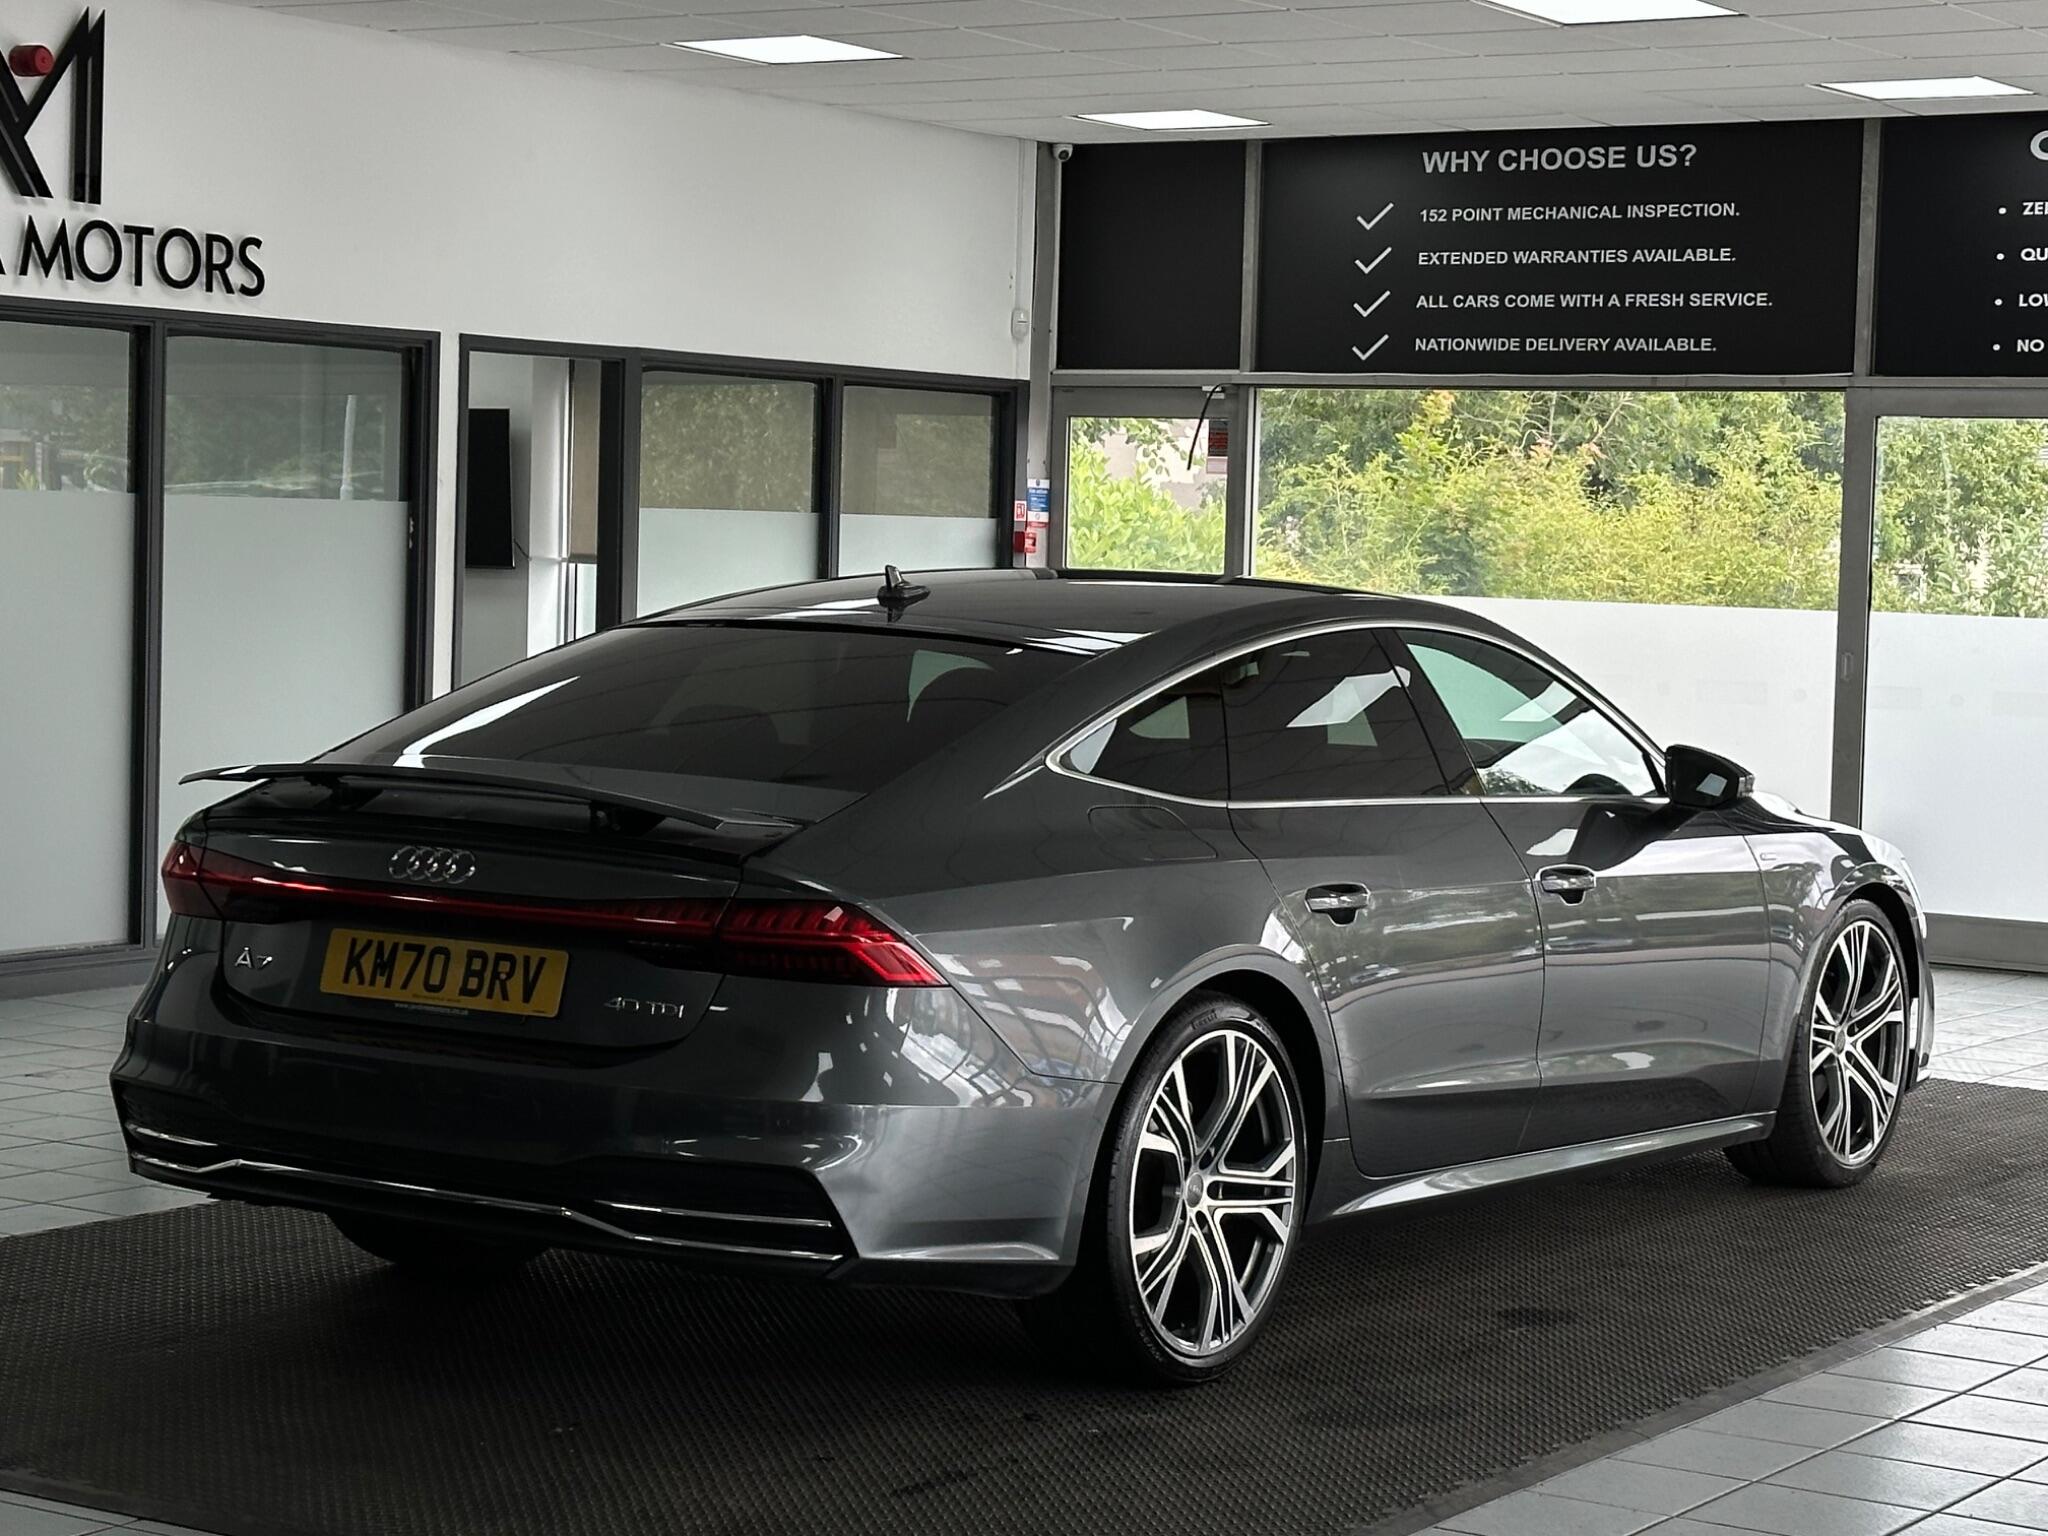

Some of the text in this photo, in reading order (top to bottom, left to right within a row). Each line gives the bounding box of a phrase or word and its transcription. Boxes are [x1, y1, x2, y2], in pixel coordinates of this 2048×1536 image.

[1422, 143, 1697, 174] WHY CHOOSE US?
[1419, 202, 1740, 223] 152 POINT MECHANICAL INSPECTION.
[19, 214, 265, 297] MOTORS
[1418, 247, 1736, 266] EXTENDED WARRANTIES AVAILABLE.
[1415, 292, 1773, 309] ALL CARS COME WITH A FRESH SERVICE.
[1415, 337, 1717, 352] NATIONWIDE DELIVERY AVAILABLE.
[2016, 338, 2045, 353] NO
[234, 946, 273, 969] A7
[342, 937, 547, 1004] KM70 BRV
[646, 1000, 685, 1019] TDI
